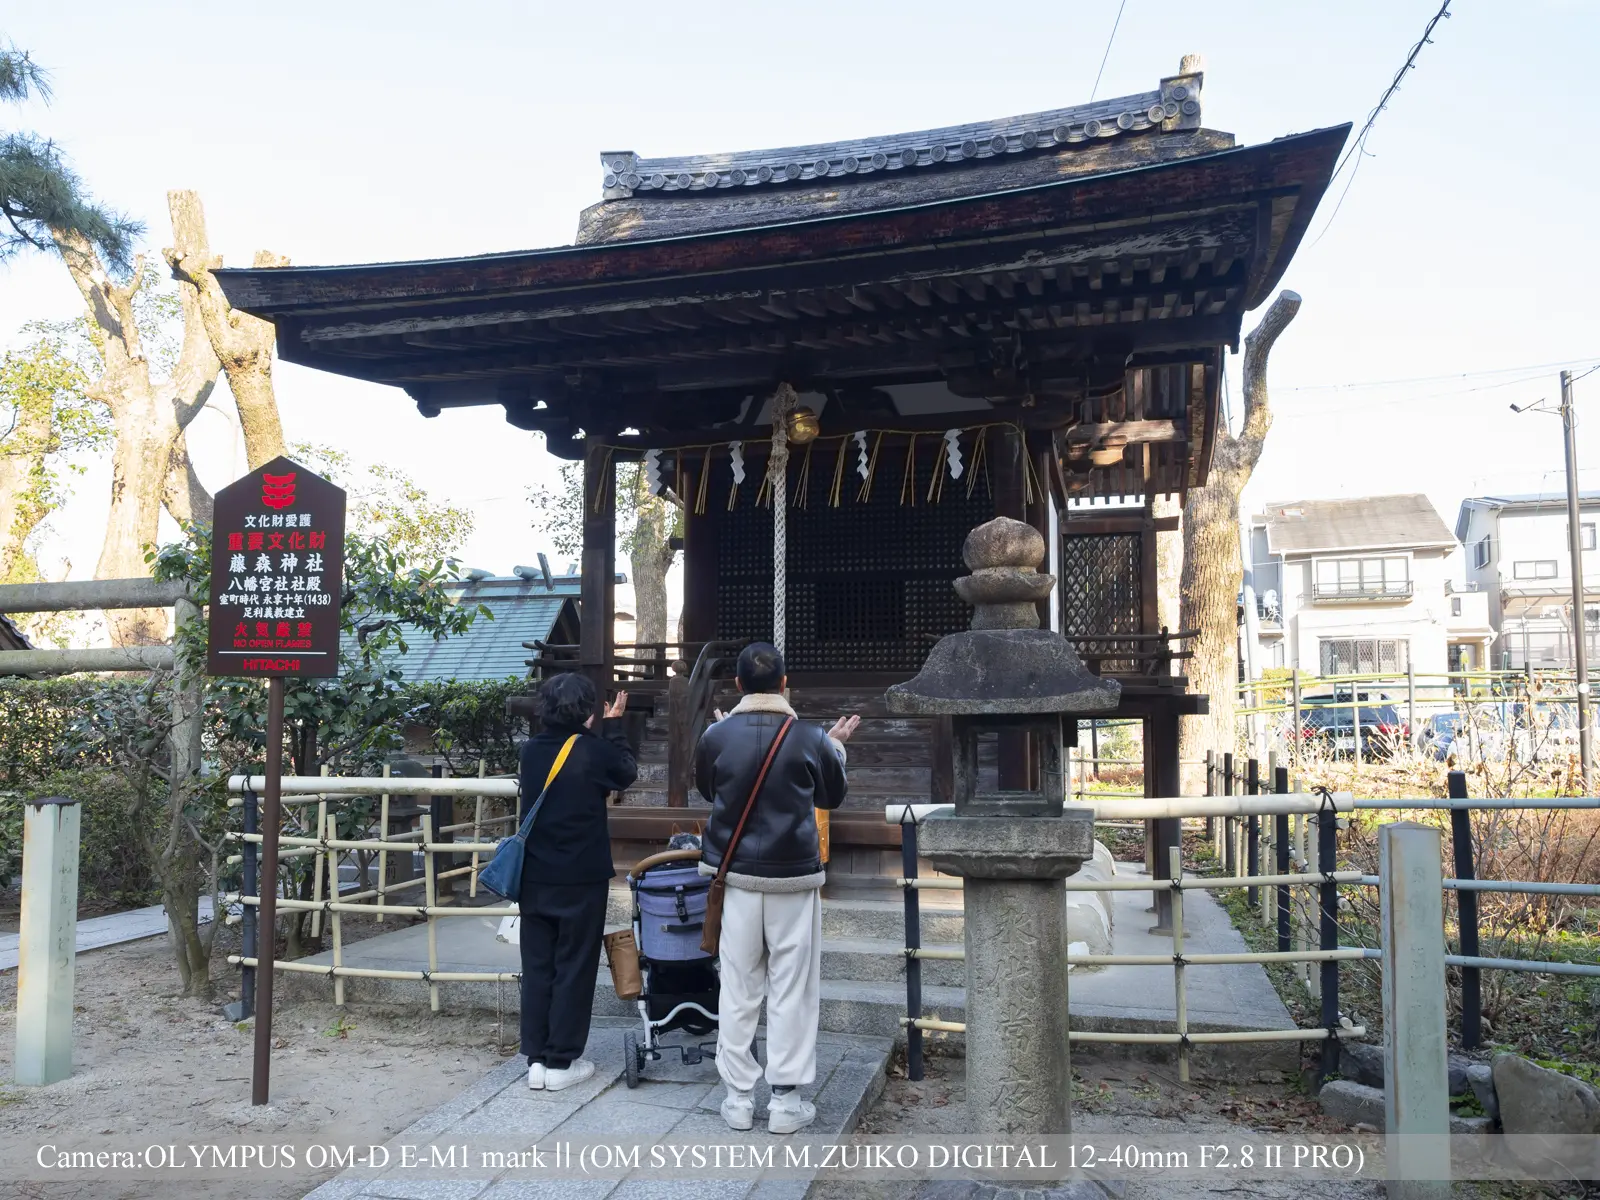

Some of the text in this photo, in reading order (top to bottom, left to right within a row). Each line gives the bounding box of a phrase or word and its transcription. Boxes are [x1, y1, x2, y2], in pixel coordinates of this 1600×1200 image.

[244, 513, 312, 528] 文化財愛護
[228, 531, 327, 551] 重要文化財
[228, 553, 325, 574] 藤森神社
[228, 576, 322, 592] 八幡宮社社殿
[219, 593, 259, 606] 室町時代
[243, 606, 305, 619] 足利義教建立
[234, 621, 313, 638] 火気厳禁
[233, 639, 312, 649] NO OPEN FLAMES
[243, 658, 301, 671] HITACHI
